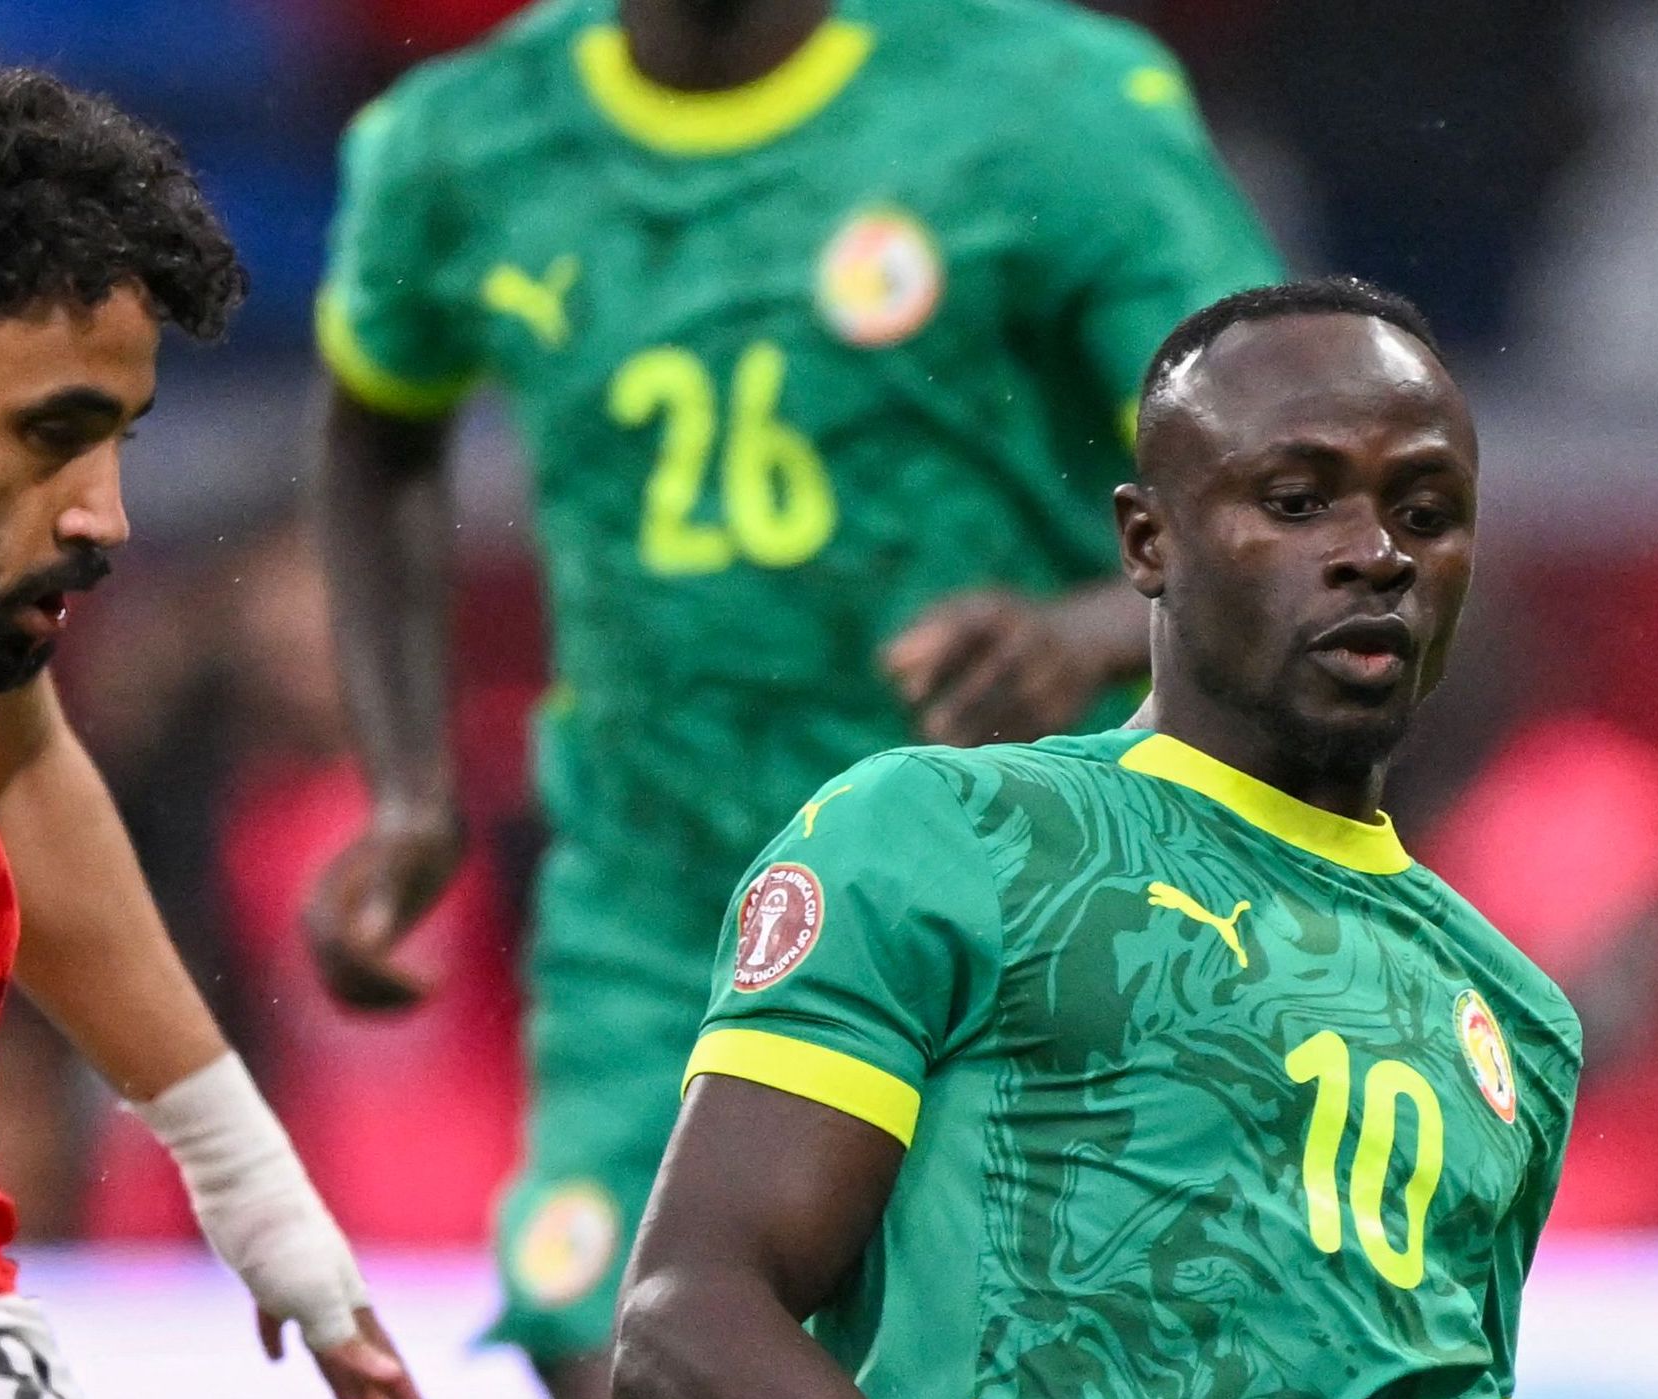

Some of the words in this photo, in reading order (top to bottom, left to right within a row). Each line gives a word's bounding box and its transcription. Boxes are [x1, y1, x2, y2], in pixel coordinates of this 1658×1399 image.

[608, 340, 836, 576] 26
[785, 871, 814, 901] AFRICA
[804, 900, 816, 926] CUP
[797, 929, 811, 948] OF
[752, 946, 800, 983] NATIONS
[1284, 1029, 1444, 1290] 10
